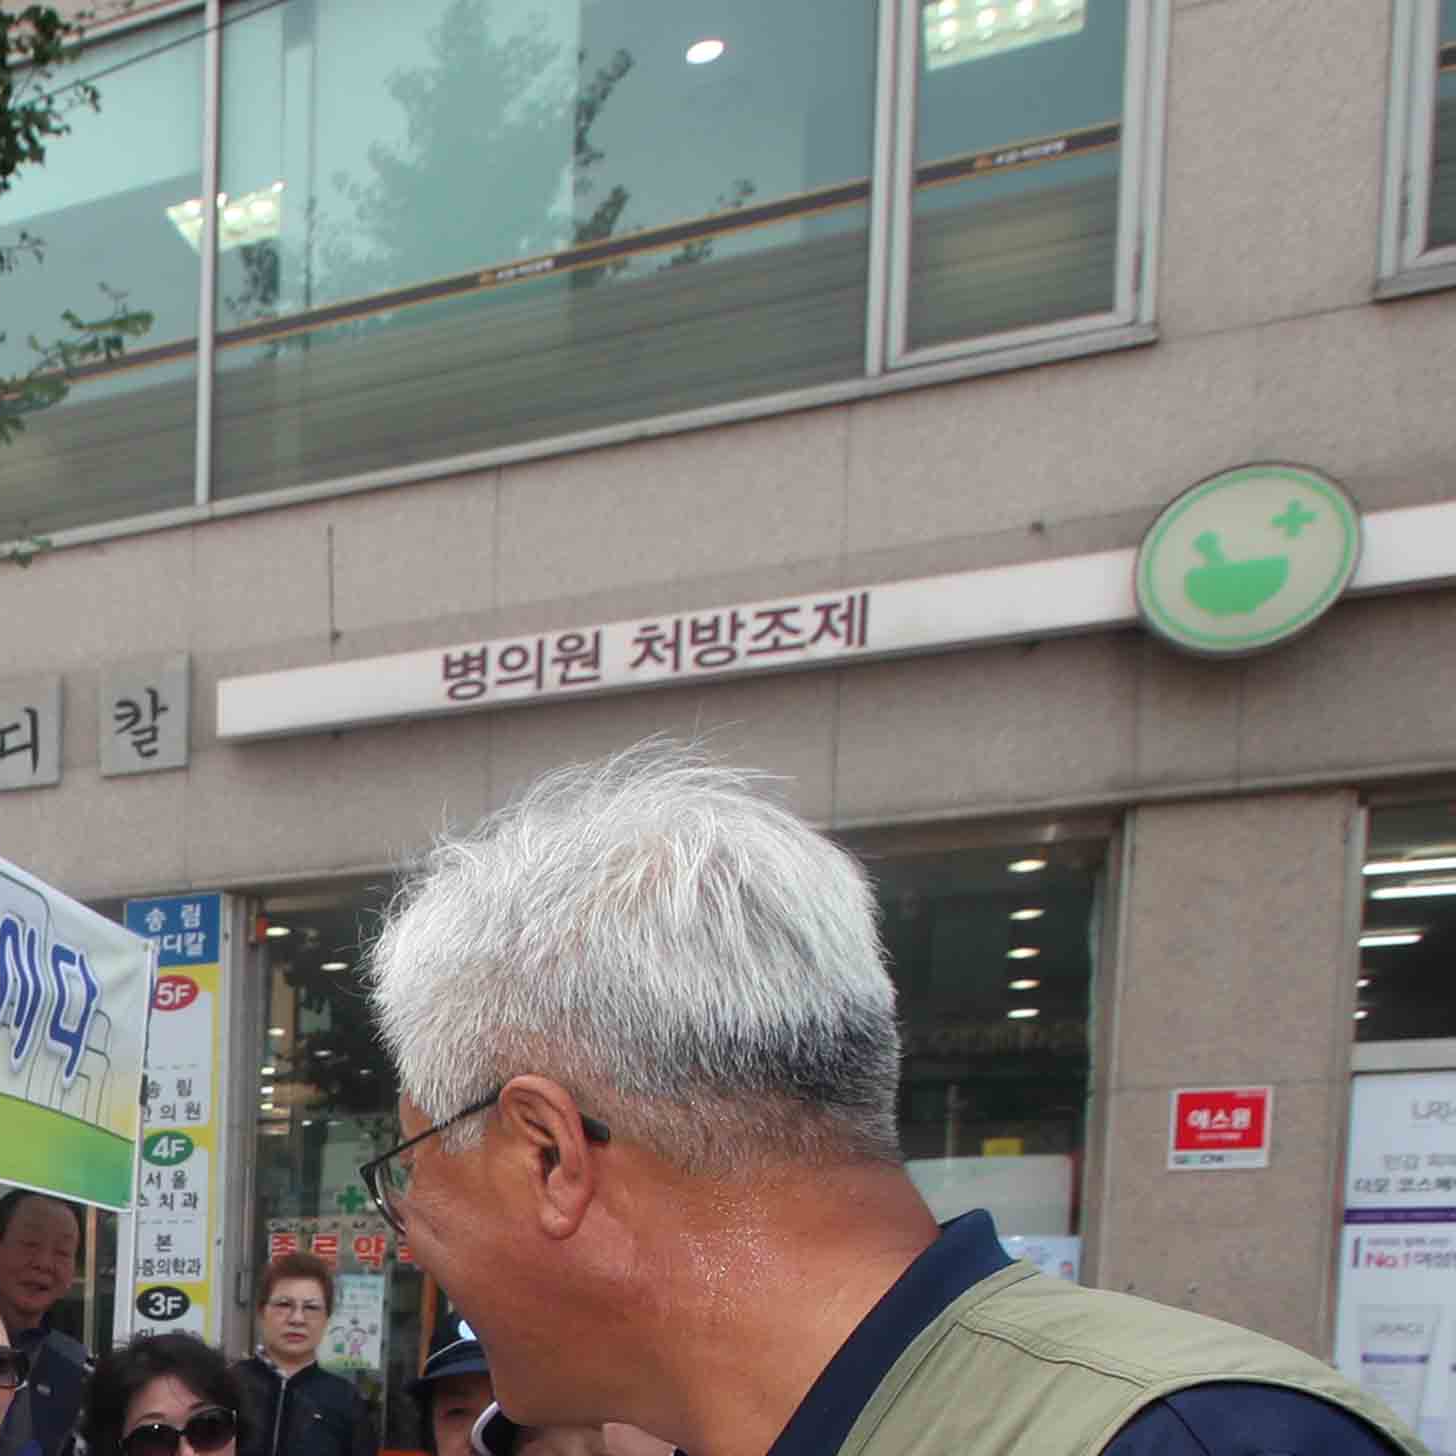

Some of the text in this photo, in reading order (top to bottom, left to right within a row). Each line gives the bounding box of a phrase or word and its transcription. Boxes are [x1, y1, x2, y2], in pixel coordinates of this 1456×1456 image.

[442, 591, 870, 702] 병의원 처방조제
[152, 930, 207, 957] 디칼
[157, 981, 191, 1006] 5F
[151, 1135, 187, 1160] 4F
[154, 1233, 173, 1253] 본
[136, 1256, 201, 1277] 증의학과
[148, 1292, 183, 1317] 3F
